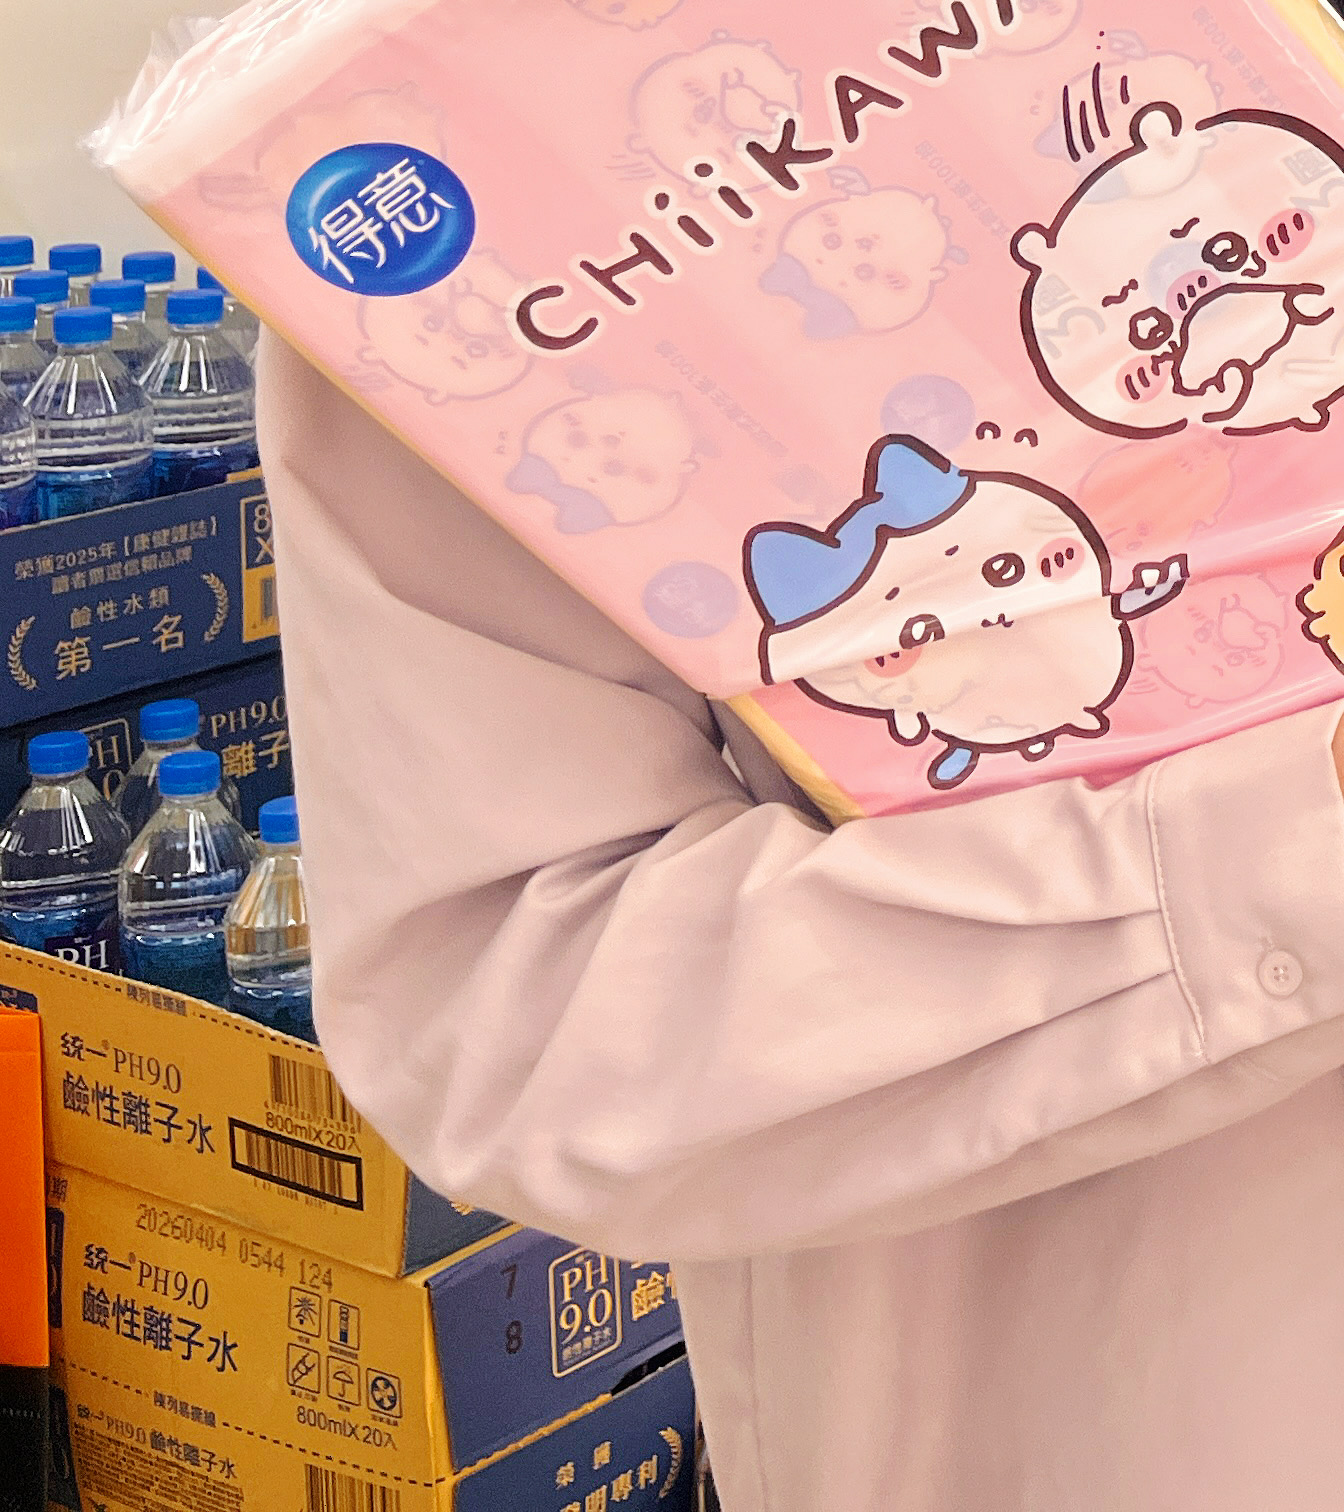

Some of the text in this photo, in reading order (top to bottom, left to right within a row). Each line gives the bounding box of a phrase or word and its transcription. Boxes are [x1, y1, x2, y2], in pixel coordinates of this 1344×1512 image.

[308, 156, 454, 286] 得意
[54, 614, 186, 681] 第一名
[222, 730, 289, 779] 離子
[60, 1031, 182, 1095] 統一 PH9.0
[61, 1069, 216, 1155] 鹼性離子水
[83, 1243, 210, 1311] 統一 PH9.0
[136, 1203, 334, 1292] 20260404 0544 124
[561, 1253, 609, 1304] PH
[82, 1282, 239, 1373] 鹼性離子水
[559, 1288, 614, 1346] 9.0
[149, 1428, 238, 1479] 鹼性離子水
